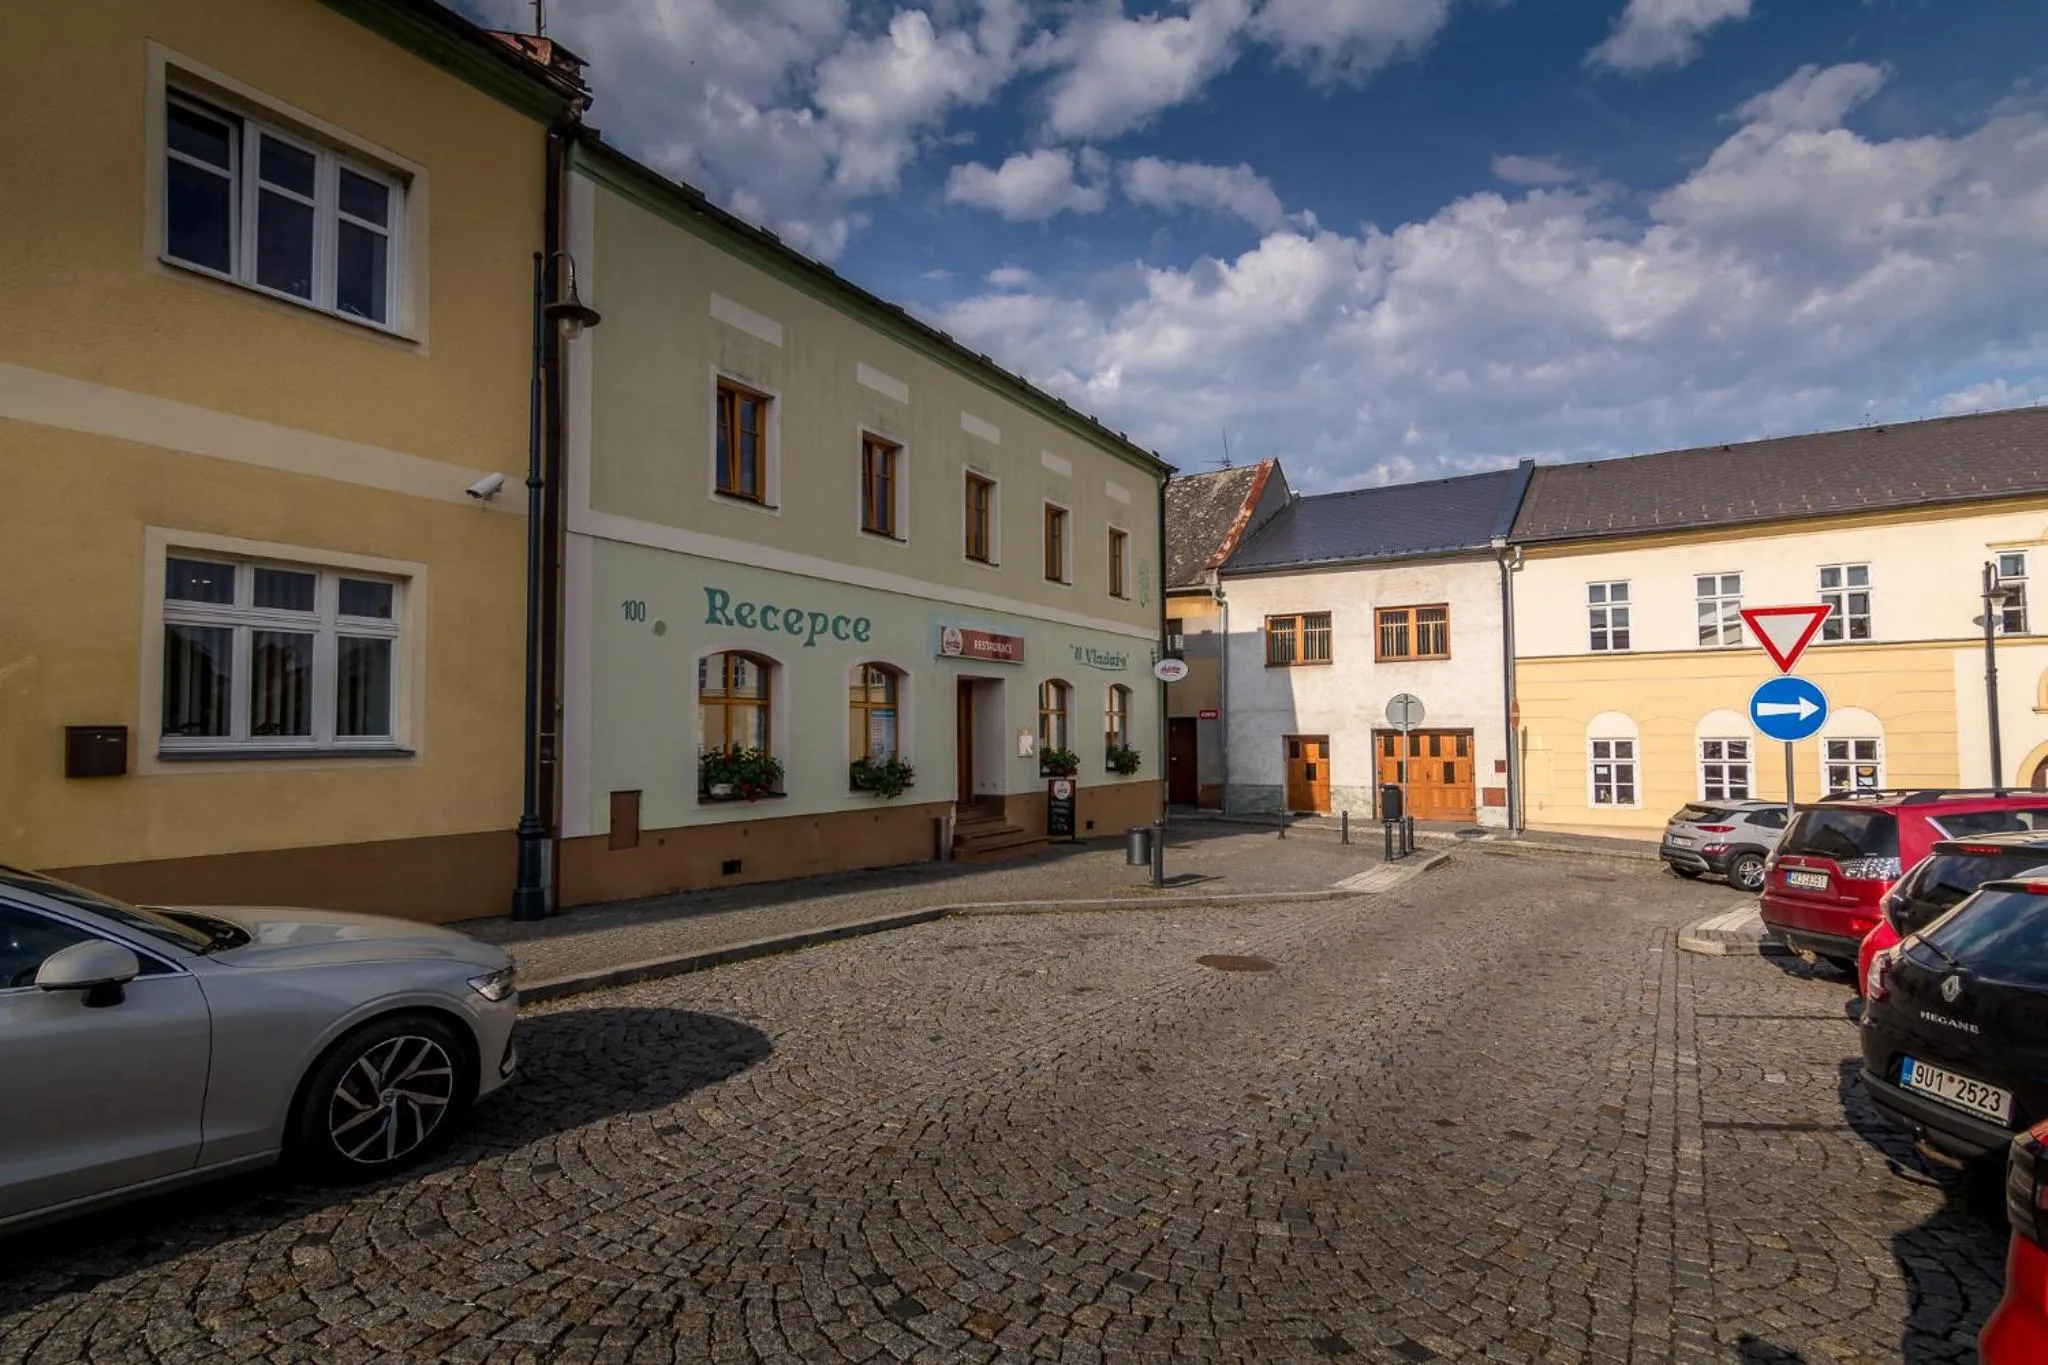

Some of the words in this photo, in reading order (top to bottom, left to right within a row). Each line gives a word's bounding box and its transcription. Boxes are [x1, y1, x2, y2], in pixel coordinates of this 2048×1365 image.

[621, 600, 646, 623] 100
[703, 586, 871, 648] Recepce
[1914, 1065, 1944, 1092] 9U1
[1955, 1079, 2001, 1112] 2523
